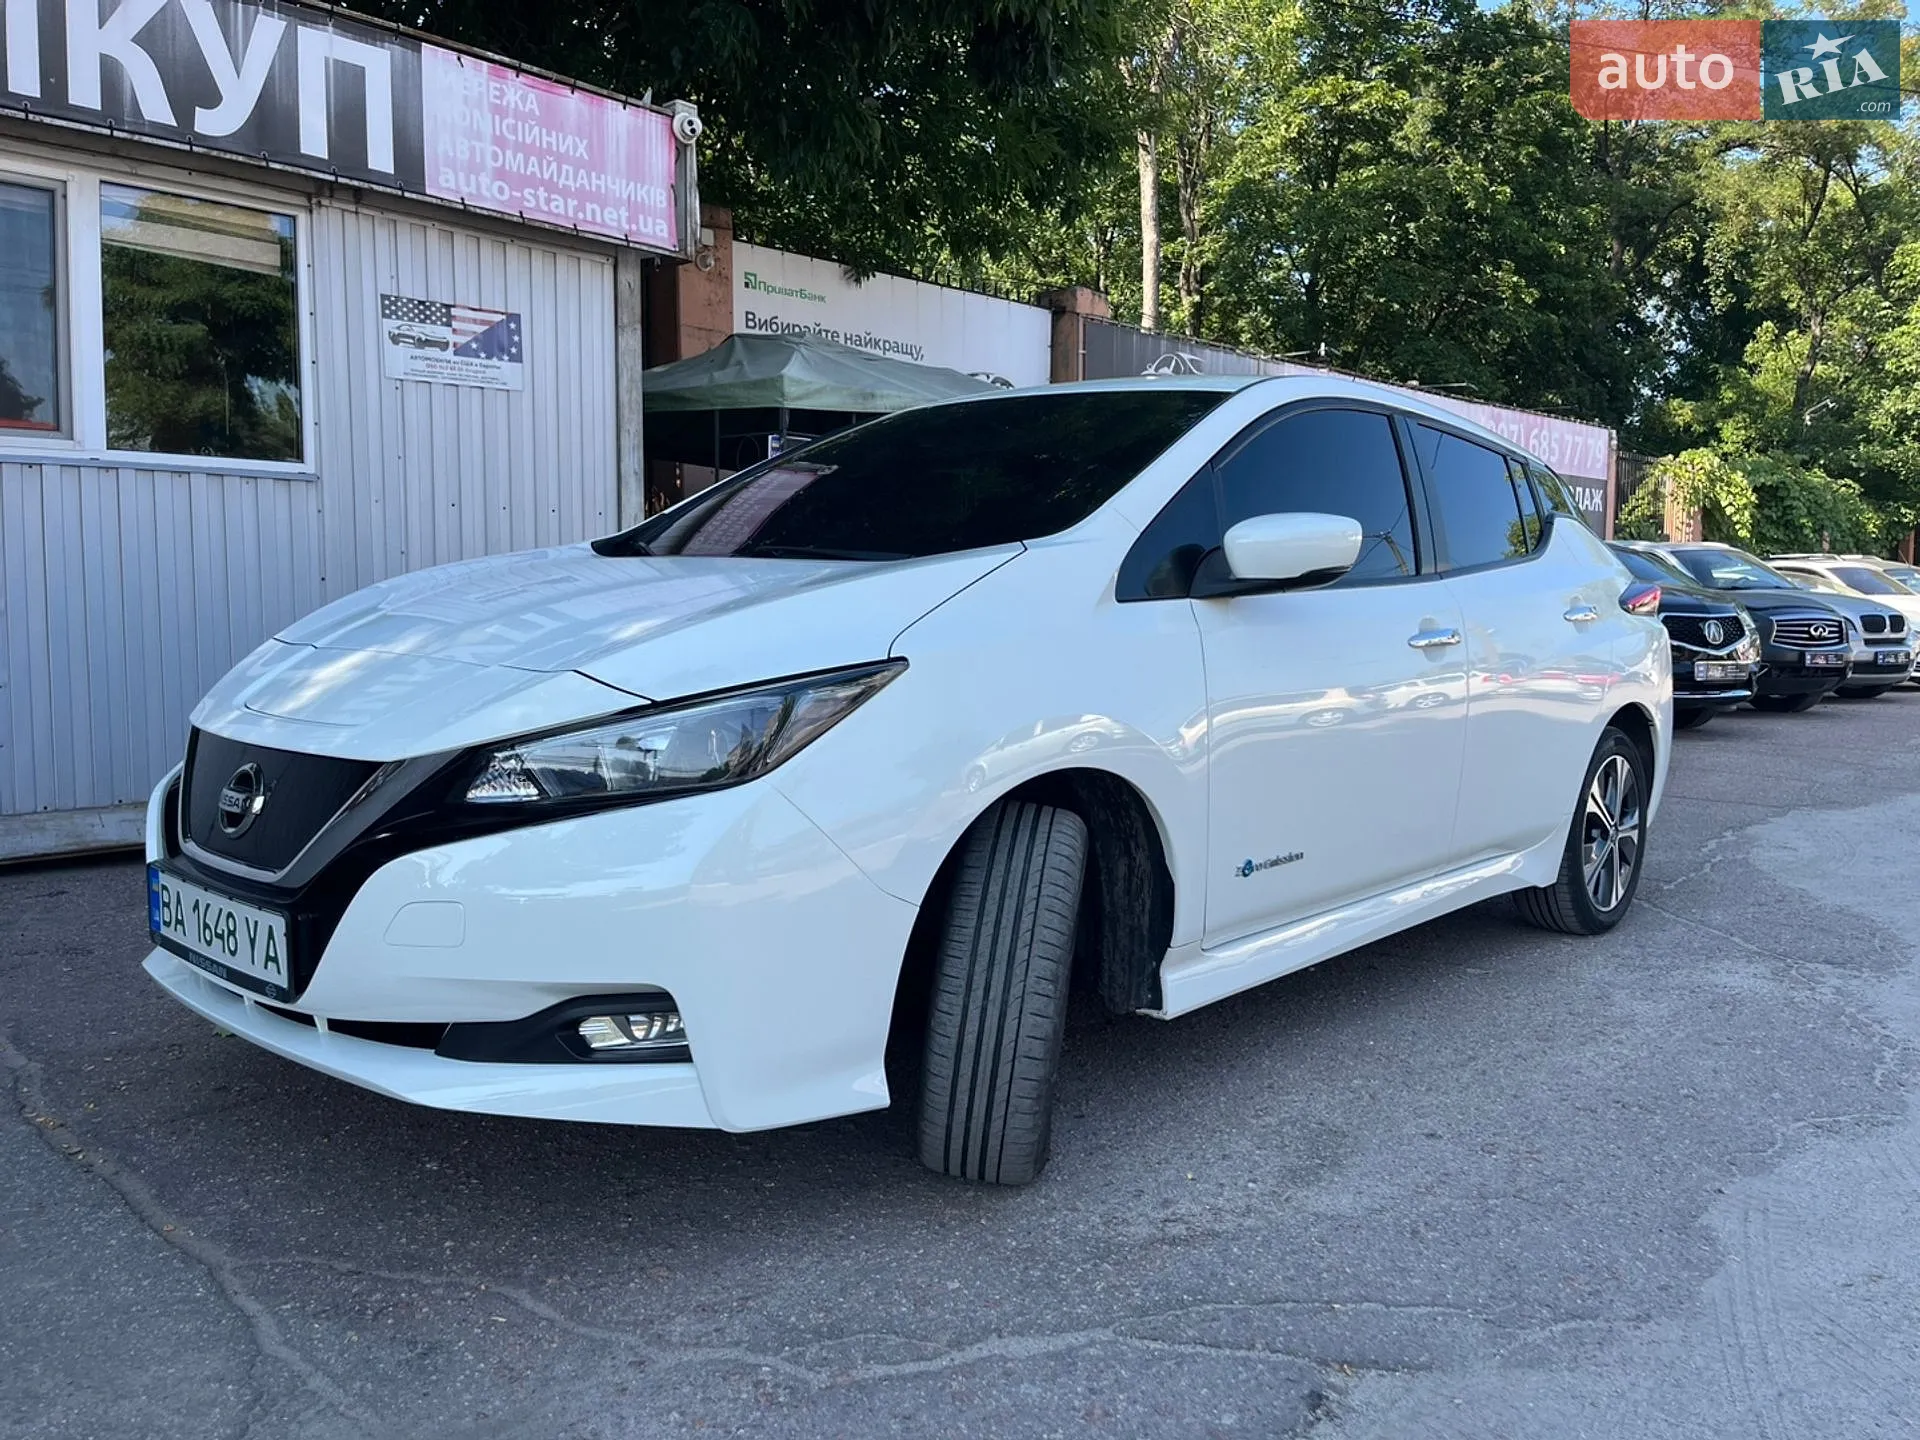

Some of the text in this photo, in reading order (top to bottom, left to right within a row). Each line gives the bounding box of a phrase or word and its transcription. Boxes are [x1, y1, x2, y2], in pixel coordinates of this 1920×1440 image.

[437, 165, 670, 238] auto-star.net.ua
[757, 280, 827, 304] ПриватБанк
[843, 330, 925, 362] найкращу,
[1529, 426, 1559, 463] 685
[1564, 434, 1585, 467] 77
[1586, 438, 1604, 470] 79
[161, 883, 187, 937] BA
[192, 897, 240, 958] 1648
